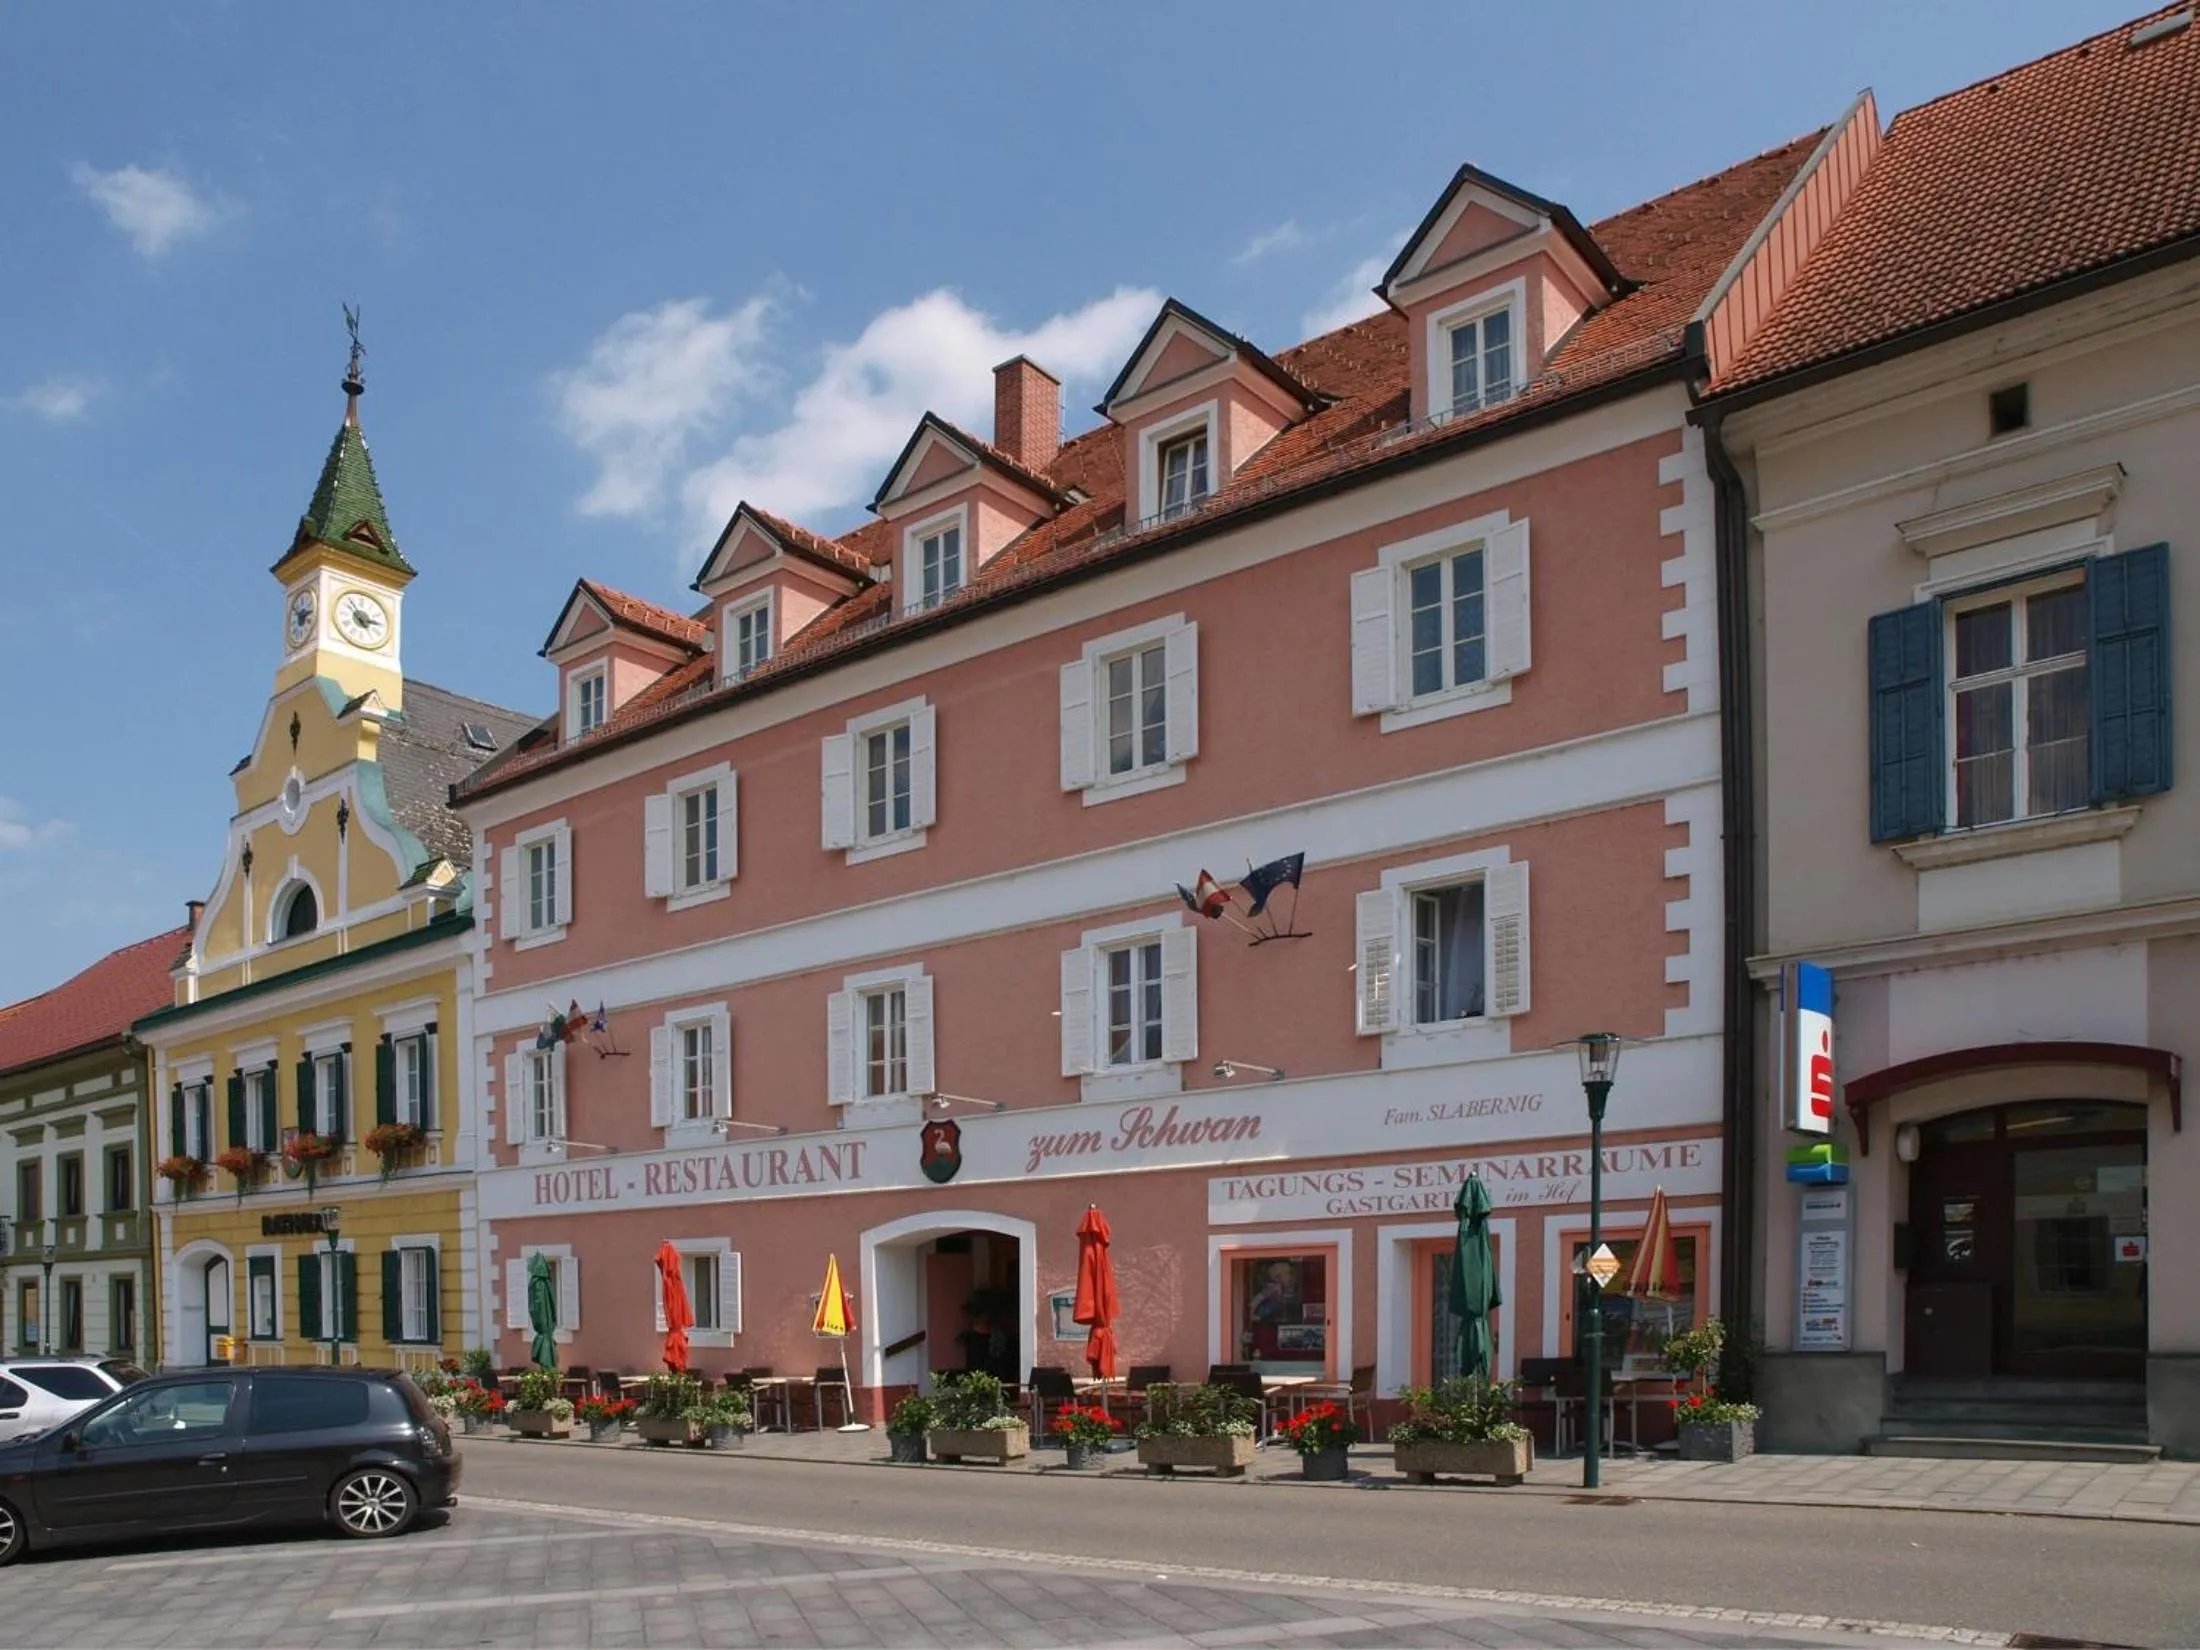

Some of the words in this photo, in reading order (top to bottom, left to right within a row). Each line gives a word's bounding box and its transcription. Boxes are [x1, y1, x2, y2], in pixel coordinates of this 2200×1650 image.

[1384, 1108, 1423, 1125] Fam.
[1427, 1093, 1544, 1122] SLABERNIG
[1026, 1129, 1102, 1173] zum
[1111, 1105, 1261, 1151] Schwan
[534, 1167, 619, 1205] HOTEL
[644, 1141, 867, 1196] RESTAURANT
[1223, 1170, 1364, 1200] TAGUNGS
[1506, 1186, 1529, 1202] im
[1539, 1178, 1583, 1203] Hof
